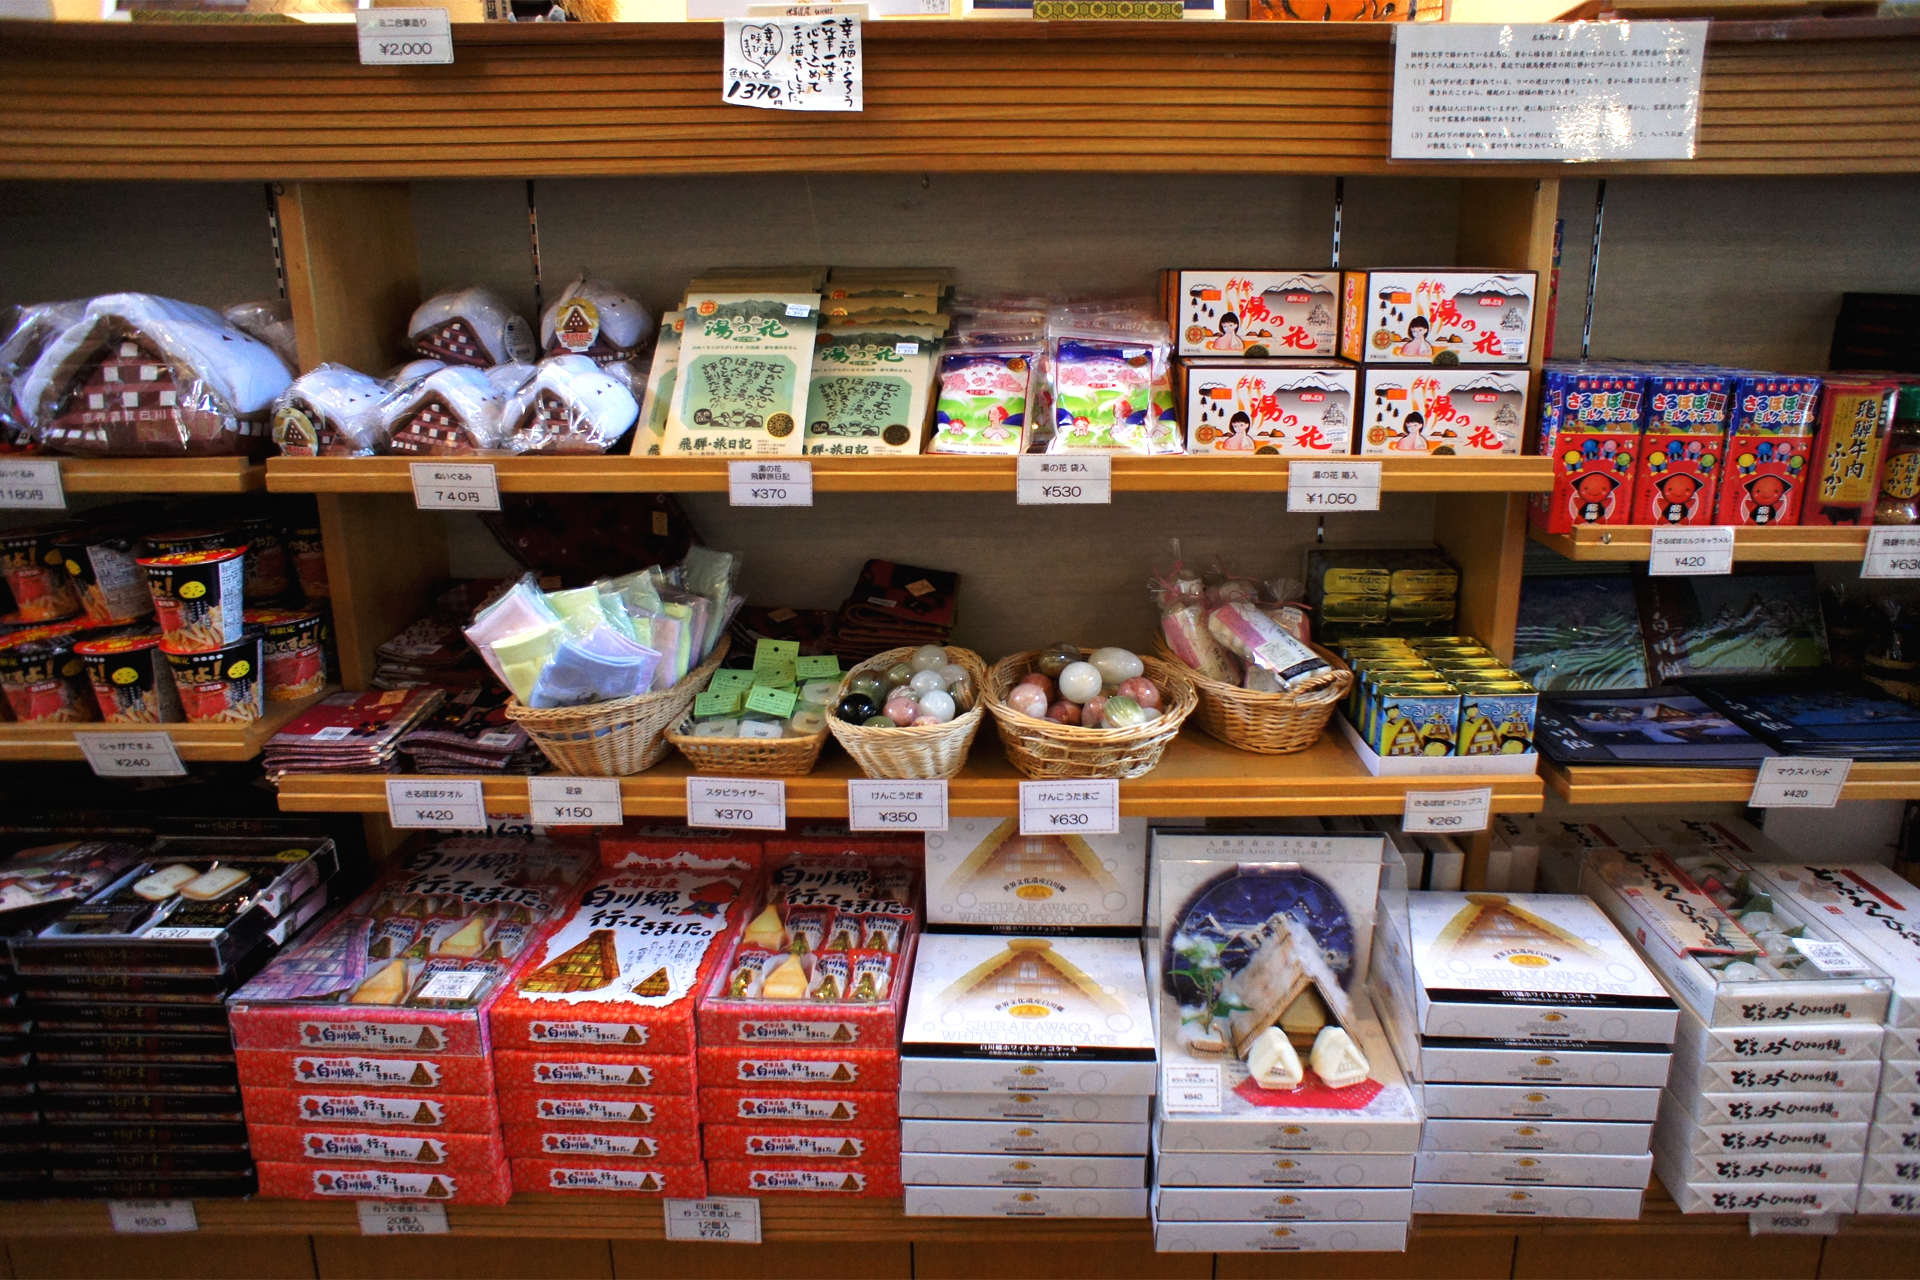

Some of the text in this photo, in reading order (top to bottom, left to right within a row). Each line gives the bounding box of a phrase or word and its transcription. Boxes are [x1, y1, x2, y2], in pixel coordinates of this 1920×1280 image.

[379, 18, 427, 28] ミニ合掌造り
[379, 42, 433, 56] ¥2,000
[821, 19, 836, 85] 一筆一筆
[804, 27, 822, 93] 心を込めて
[839, 17, 857, 107] 幸福ふくろう
[704, 318, 790, 340] 湯の花
[1239, 295, 1319, 351] 湯の花
[1429, 299, 1508, 356] 湯の花
[821, 346, 904, 364] 湯の花
[1578, 380, 1635, 390] おまけ入り
[1664, 382, 1722, 391] おまけ入り
[1755, 382, 1812, 393] おまけ入り
[1566, 391, 1623, 410] さるぼぼ
[1652, 392, 1708, 411] さるぼぼ
[1743, 393, 1799, 413] さるぼぼ
[1578, 408, 1640, 423] ミルクキャラメル
[1664, 408, 1726, 423] ミルクキャラメル
[1754, 410, 1815, 425] ミルクキャラメル
[1250, 394, 1333, 451] 湯の花
[1424, 395, 1504, 451] 湯の花
[678, 436, 753, 451] 飛騨・旅日記
[1844, 399, 1879, 480] 飛騨牛肉
[758, 464, 783, 473] 湯の花
[1040, 462, 1089, 474] 湯の花 袋入
[1823, 441, 1849, 499] ふりかけ
[434, 472, 473, 482] ぬいぐるみ
[750, 472, 791, 482] 飛騨旅日記
[1311, 470, 1360, 481] 湯の花 箱入
[435, 490, 481, 503] 740円
[751, 488, 788, 500] ¥370
[1041, 485, 1083, 499] ¥530
[1305, 492, 1358, 506] ¥1,050
[1656, 536, 1731, 548] さるぼぼミルクキャラメル
[1674, 555, 1707, 568] ¥420
[114, 758, 151, 767] ¥240
[405, 789, 464, 799] さるぼぼタオル
[565, 786, 583, 795] 足袋
[1038, 791, 1101, 802] けんこうたまご
[1782, 789, 1809, 798] ¥420
[416, 809, 455, 821] ¥420
[554, 806, 593, 818] ¥150
[714, 808, 754, 821] ¥370
[878, 811, 919, 823] ¥350
[1049, 813, 1090, 826] ¥630
[1427, 816, 1463, 826] ¥260
[773, 863, 875, 895] 白川郷に
[404, 873, 553, 911] 行ってきました。
[581, 884, 683, 917] 白川郷に
[785, 888, 914, 916] 行ってきました。
[979, 902, 1089, 915] SHIRAKAWAGO
[589, 909, 713, 937] 行ってきました。
[958, 912, 1111, 925] WHITE CHOCO CAKE
[697, 1220, 731, 1229] 12個入
[1771, 1216, 1811, 1227] ¥630
[386, 1224, 425, 1233] ¥1050
[699, 1229, 731, 1239] ¥740
